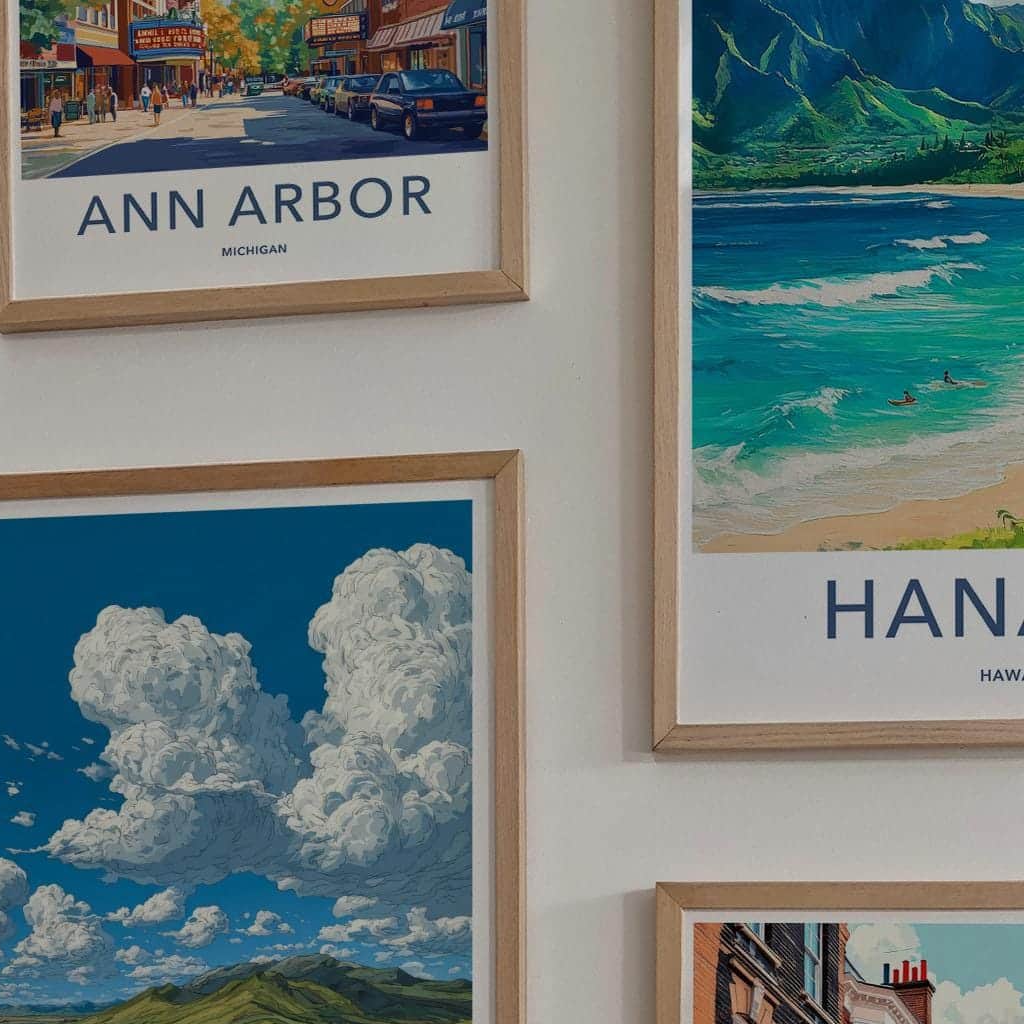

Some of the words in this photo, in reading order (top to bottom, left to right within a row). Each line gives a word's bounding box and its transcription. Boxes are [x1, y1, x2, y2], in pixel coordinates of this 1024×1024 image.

[77, 188, 205, 235] ANN
[228, 175, 433, 226] ARBOR
[221, 243, 288, 257] MICHIGAN
[827, 577, 1024, 639] HAN
[980, 668, 1024, 682] HAW
